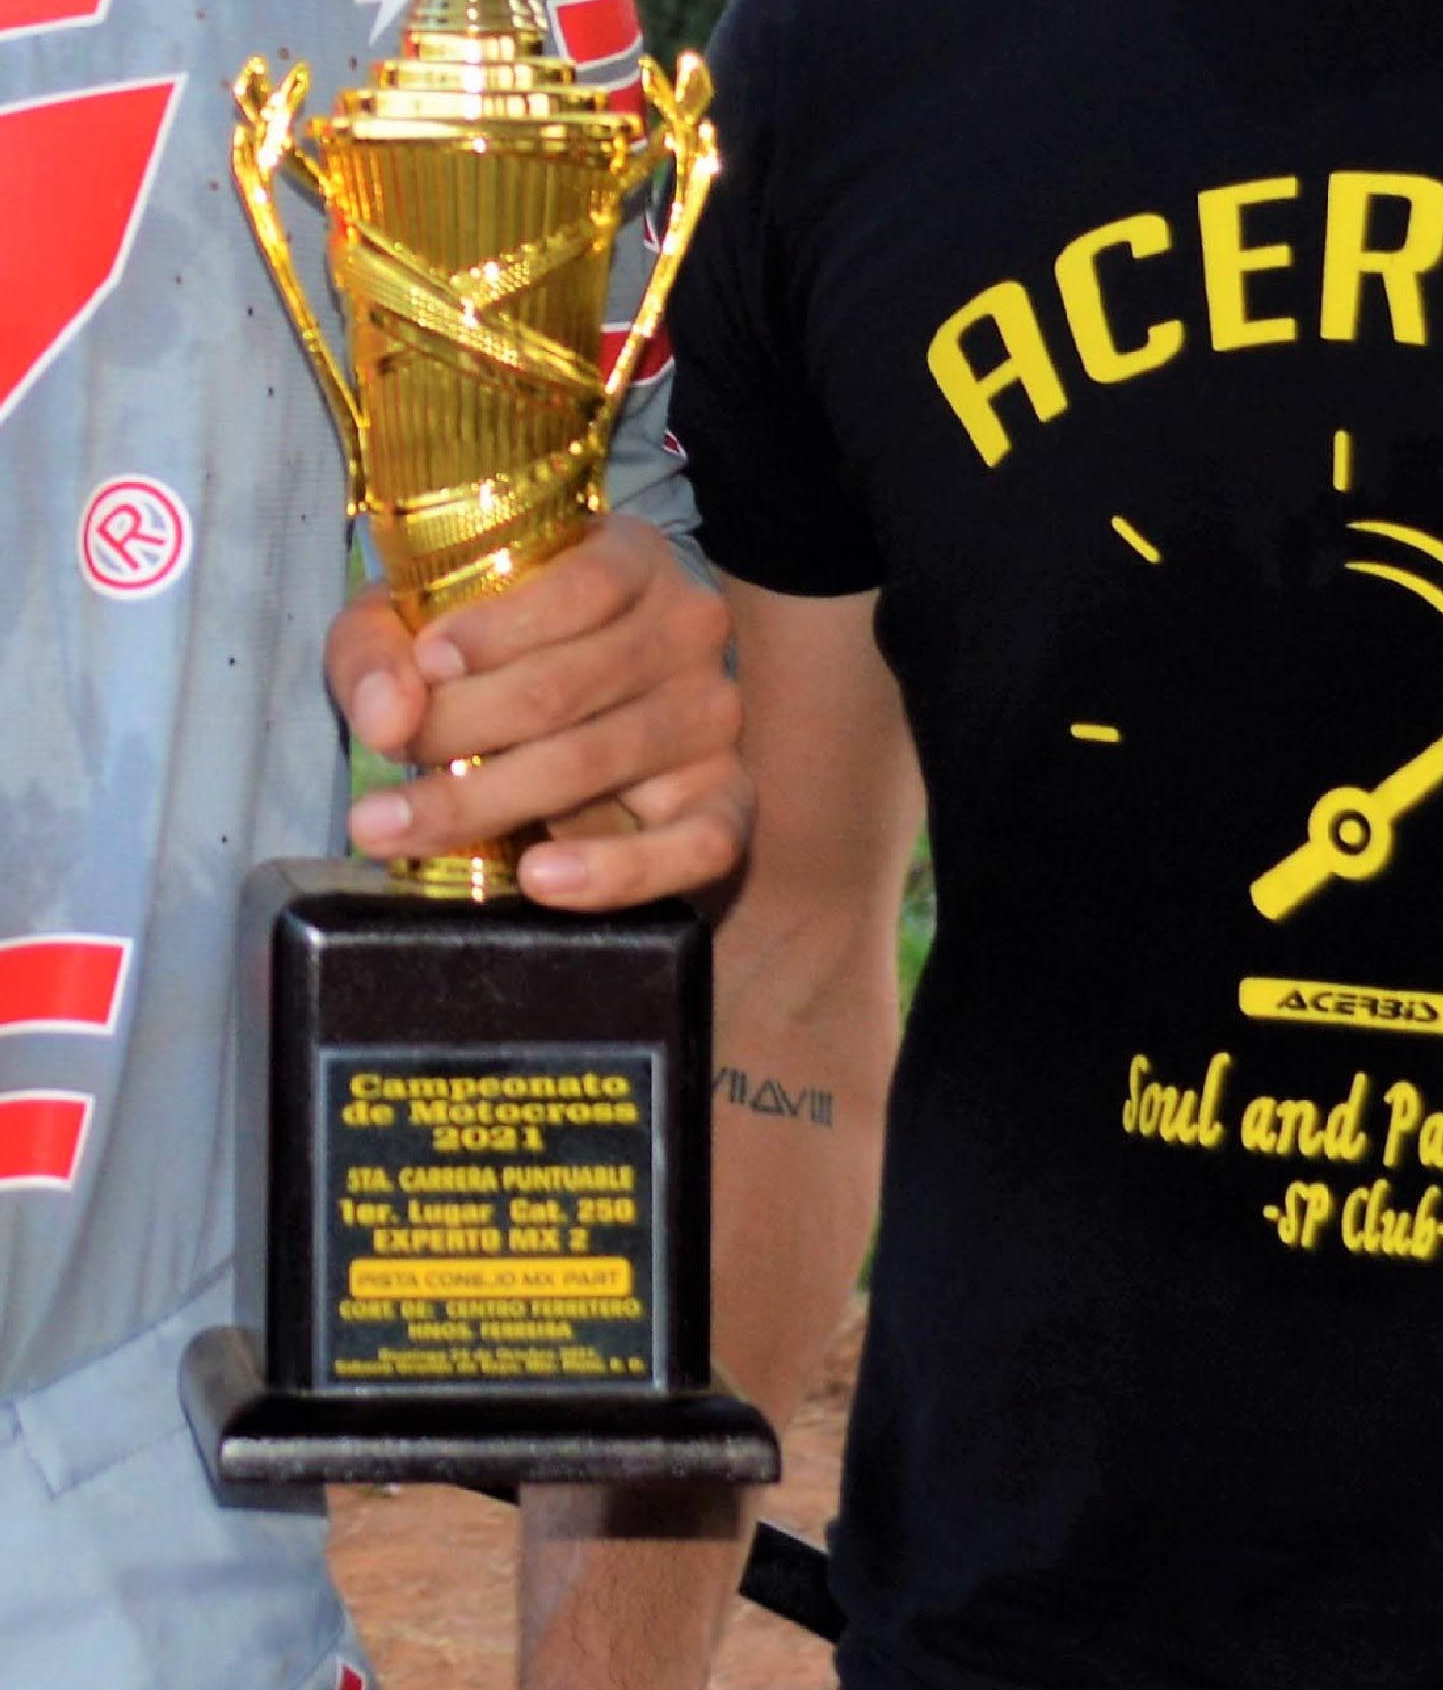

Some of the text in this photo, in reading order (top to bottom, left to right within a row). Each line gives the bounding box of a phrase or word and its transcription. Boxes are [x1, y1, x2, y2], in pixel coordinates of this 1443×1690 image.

[1275, 988, 1441, 1023] ACERBIS
[348, 1072, 631, 1102] Campeonato
[341, 1098, 639, 1127] de Motocross
[1122, 1052, 1233, 1148] Soul
[1240, 1071, 1369, 1161] and
[431, 1124, 544, 1152] 2021
[398, 1164, 499, 1193] CARRERA
[501, 1164, 635, 1192] PUNTUABLE
[338, 1196, 637, 1230] 1er. Lugar Cat. 250
[372, 1226, 590, 1254] EXPERTO MX 2
[356, 1270, 418, 1288] PISTA
[423, 1269, 516, 1288] CONEJO
[562, 1268, 620, 1287] PART
